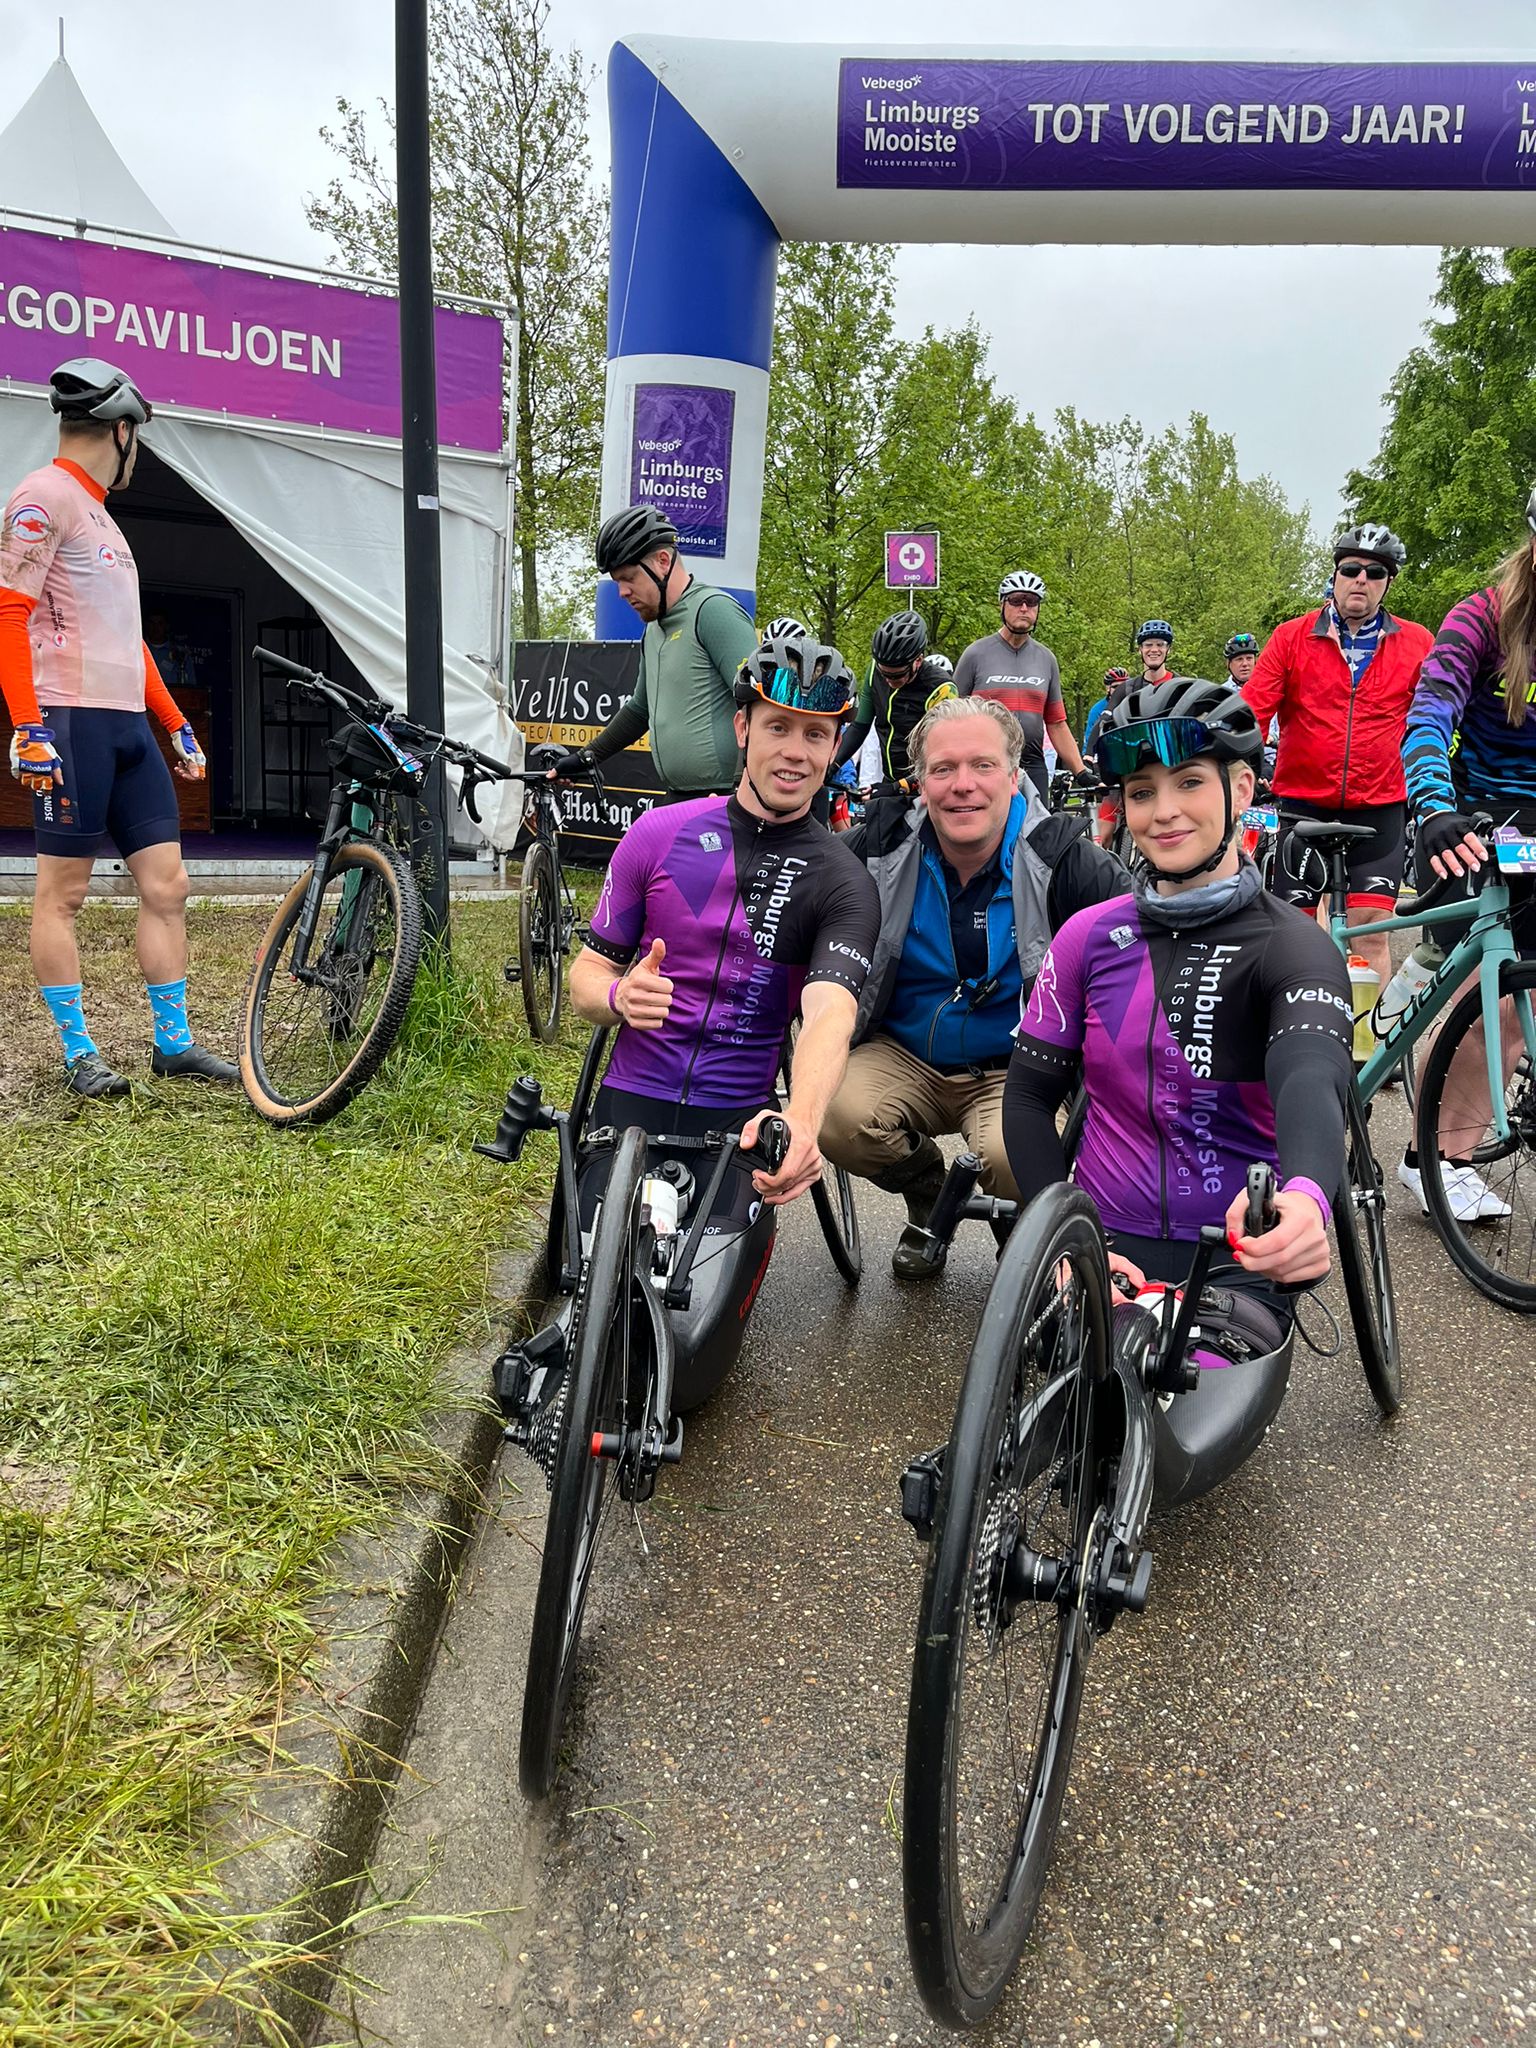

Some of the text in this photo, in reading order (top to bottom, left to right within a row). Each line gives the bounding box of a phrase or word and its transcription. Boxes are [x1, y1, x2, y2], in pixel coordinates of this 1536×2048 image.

[862, 76, 913, 92] Vebego
[865, 99, 980, 130] Limburgs
[1027, 103, 1466, 144] TOT VOLGEND JAAR!
[864, 127, 957, 153] Mooiste
[864, 158, 957, 167] fietsevenementen
[0, 281, 341, 378] GOPAVILJOEN
[638, 440, 675, 453] Vebego
[640, 458, 724, 484] Limburgs
[639, 478, 707, 499] Mooiste
[985, 675, 1045, 686] RIDLEY
[1298, 847, 1312, 880] DYKEN
[712, 853, 781, 1042] fietsevenementen
[730, 857, 809, 1044] Limburgs Mooiste
[1163, 943, 1208, 1196] fietsevenementen
[1184, 944, 1242, 1194] Limburgs Mooiste
